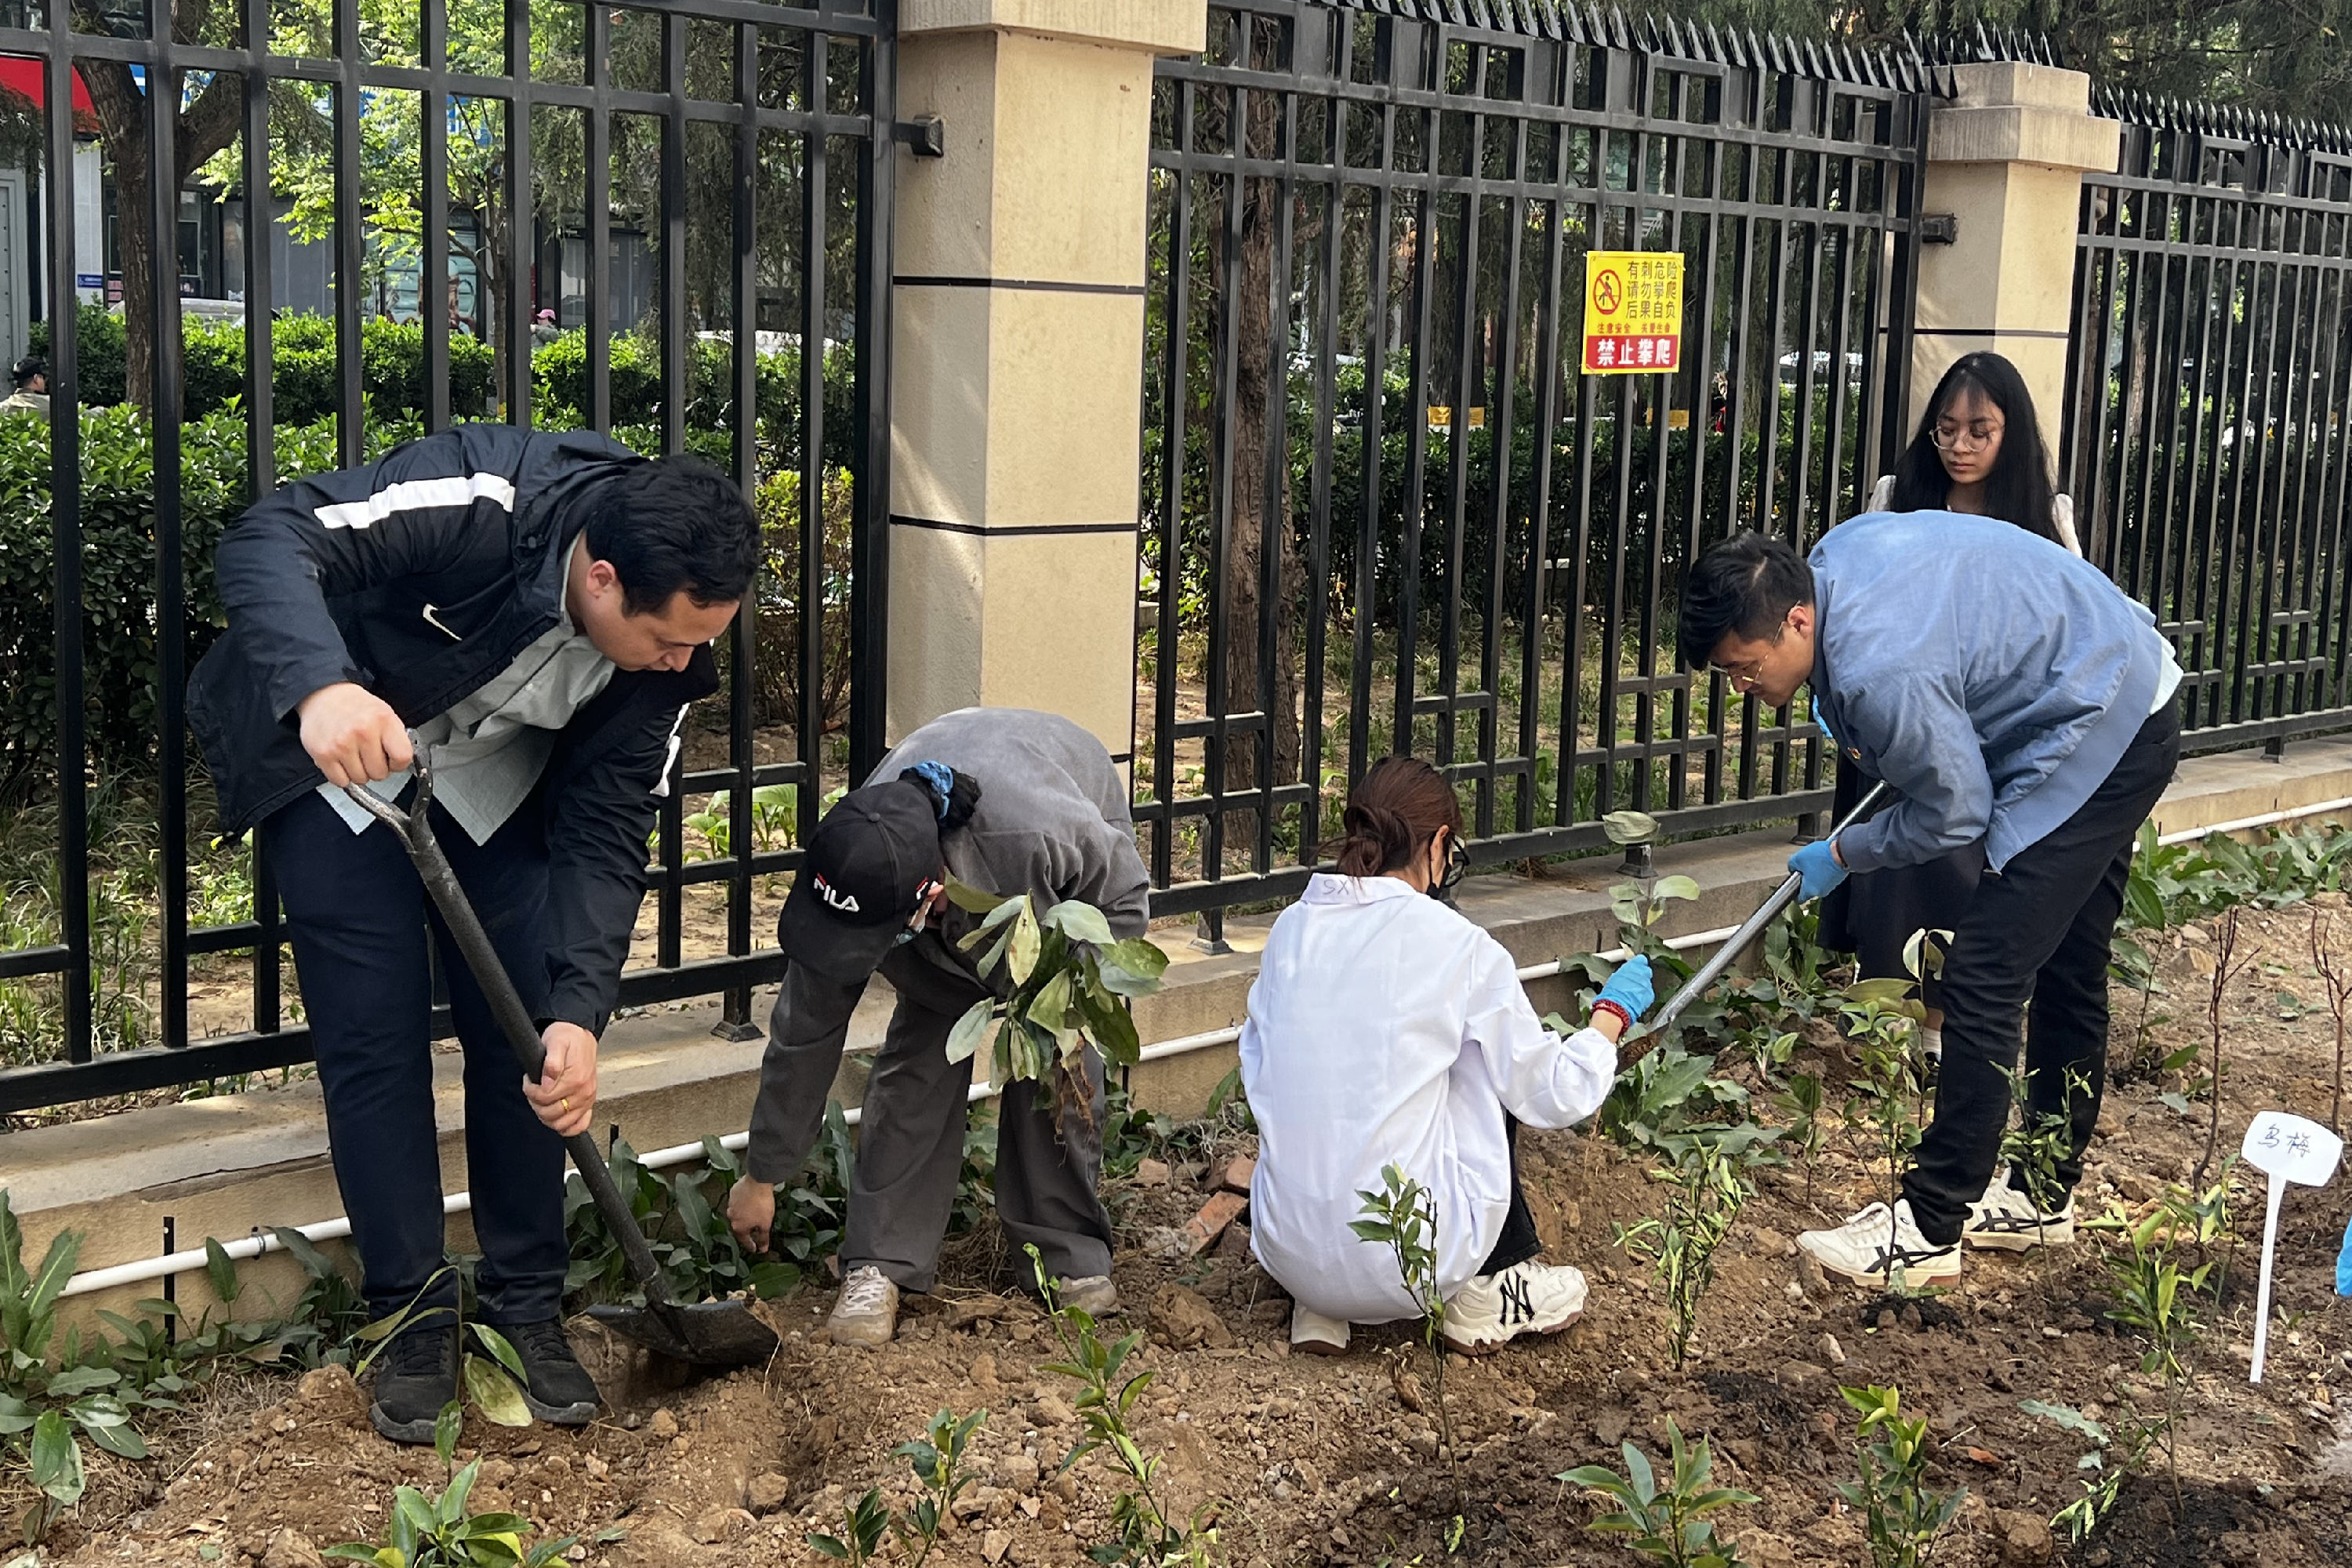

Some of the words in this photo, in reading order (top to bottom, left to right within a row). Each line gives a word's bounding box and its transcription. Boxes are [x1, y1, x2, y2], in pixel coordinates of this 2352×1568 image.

[1628, 260, 1677, 280] 有刺危险
[1627, 281, 1676, 299] 请勿攀爬
[1625, 300, 1675, 319] 后果自负
[1597, 338, 1671, 365] 禁止攀爬
[813, 872, 860, 913] FILA
